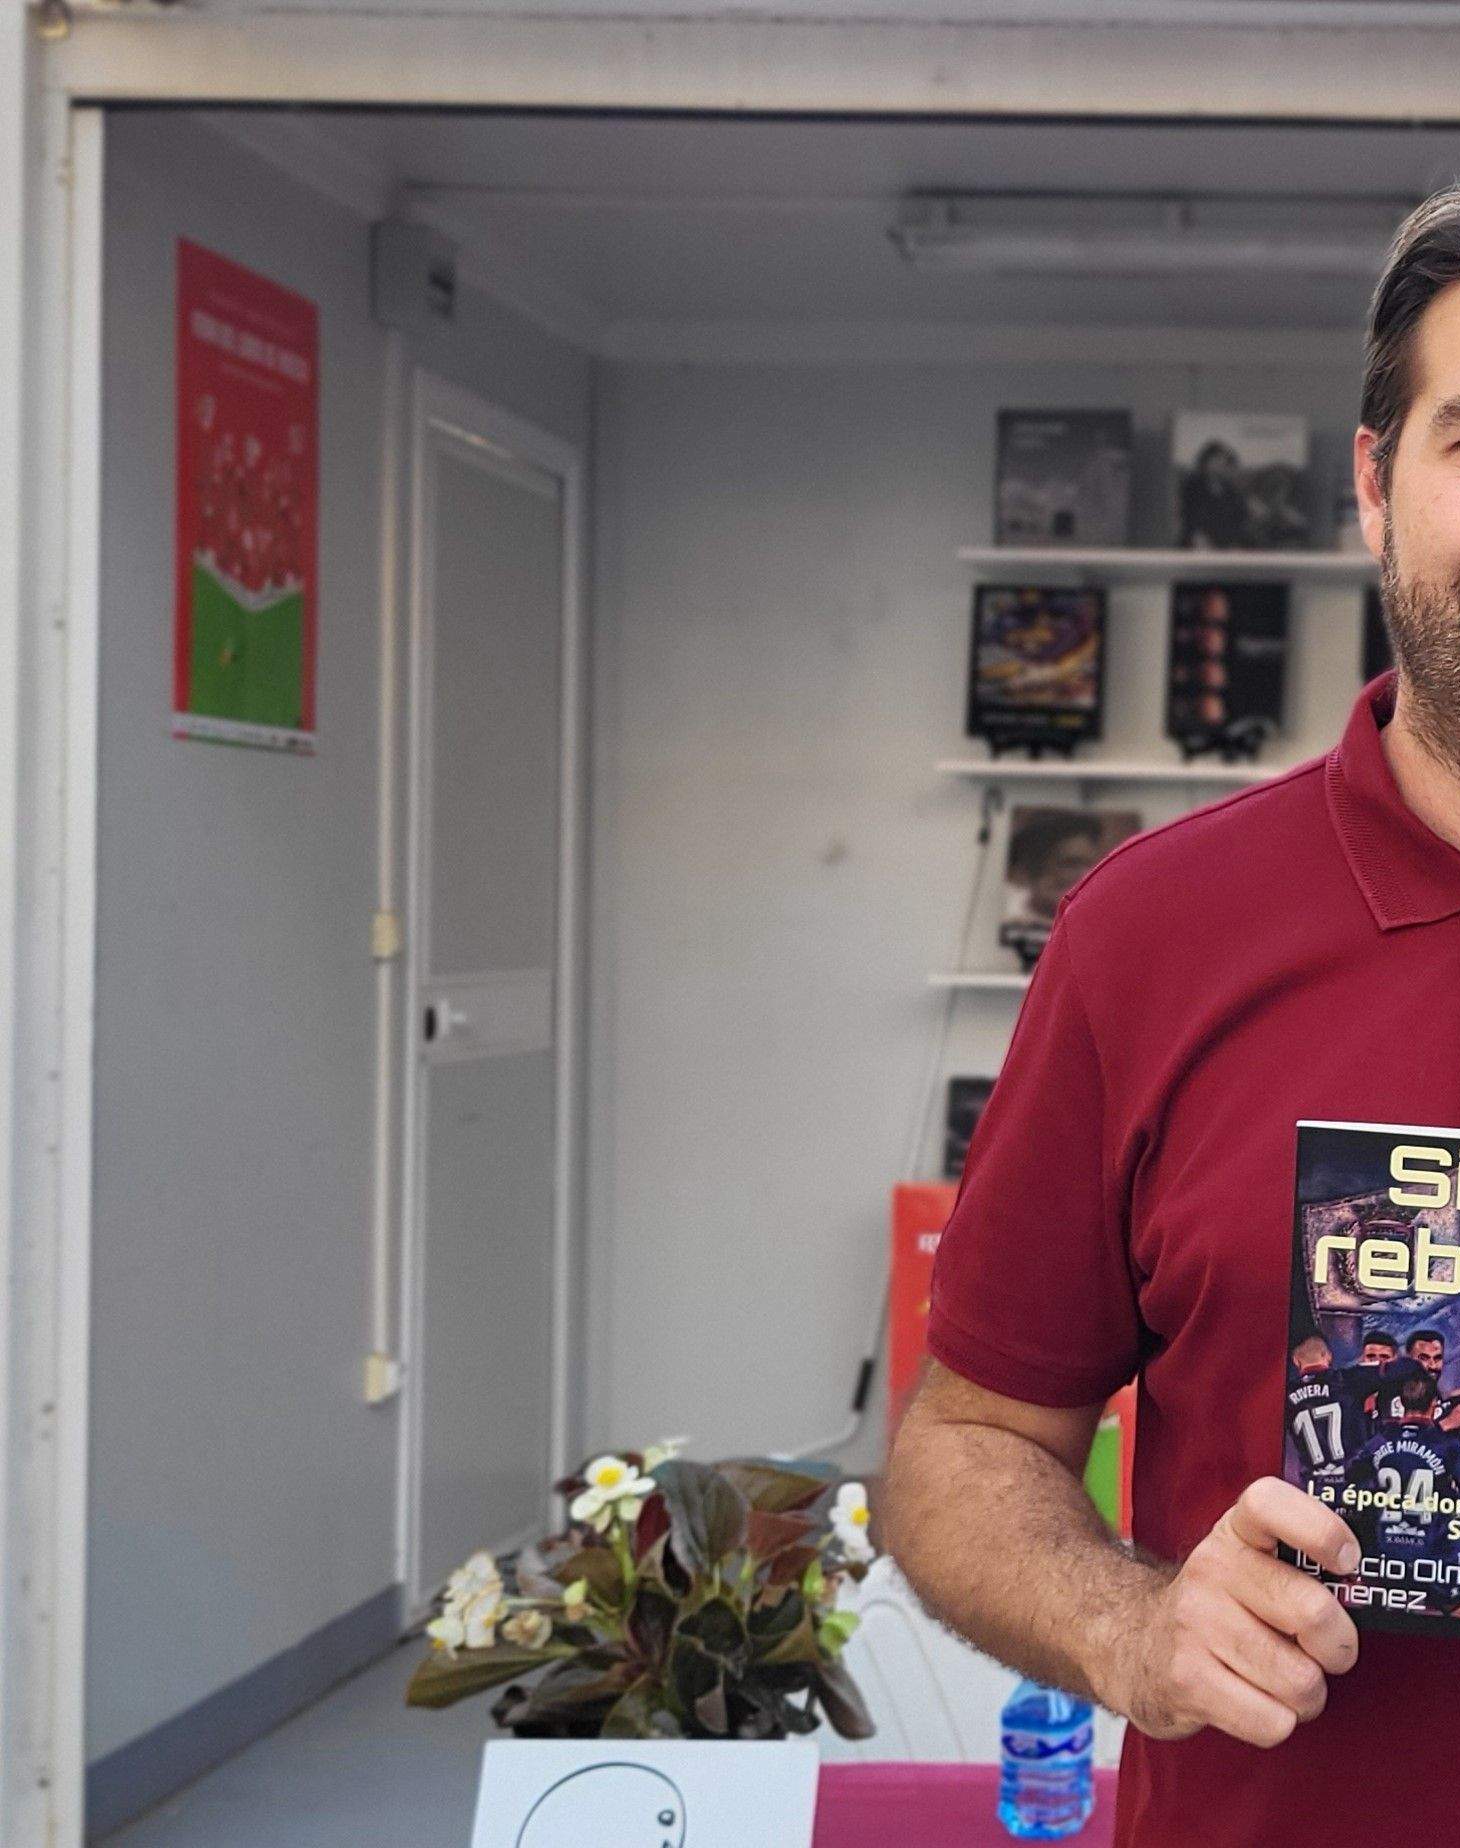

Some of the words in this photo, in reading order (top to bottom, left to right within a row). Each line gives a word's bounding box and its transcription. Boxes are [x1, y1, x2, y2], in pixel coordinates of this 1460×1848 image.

[1289, 1384, 1330, 1405] RIVERA
[1294, 1402, 1345, 1465] 17
[1307, 1480, 1335, 1501] La
[1342, 1484, 1415, 1511] época
[1323, 1576, 1428, 1611] ménez
